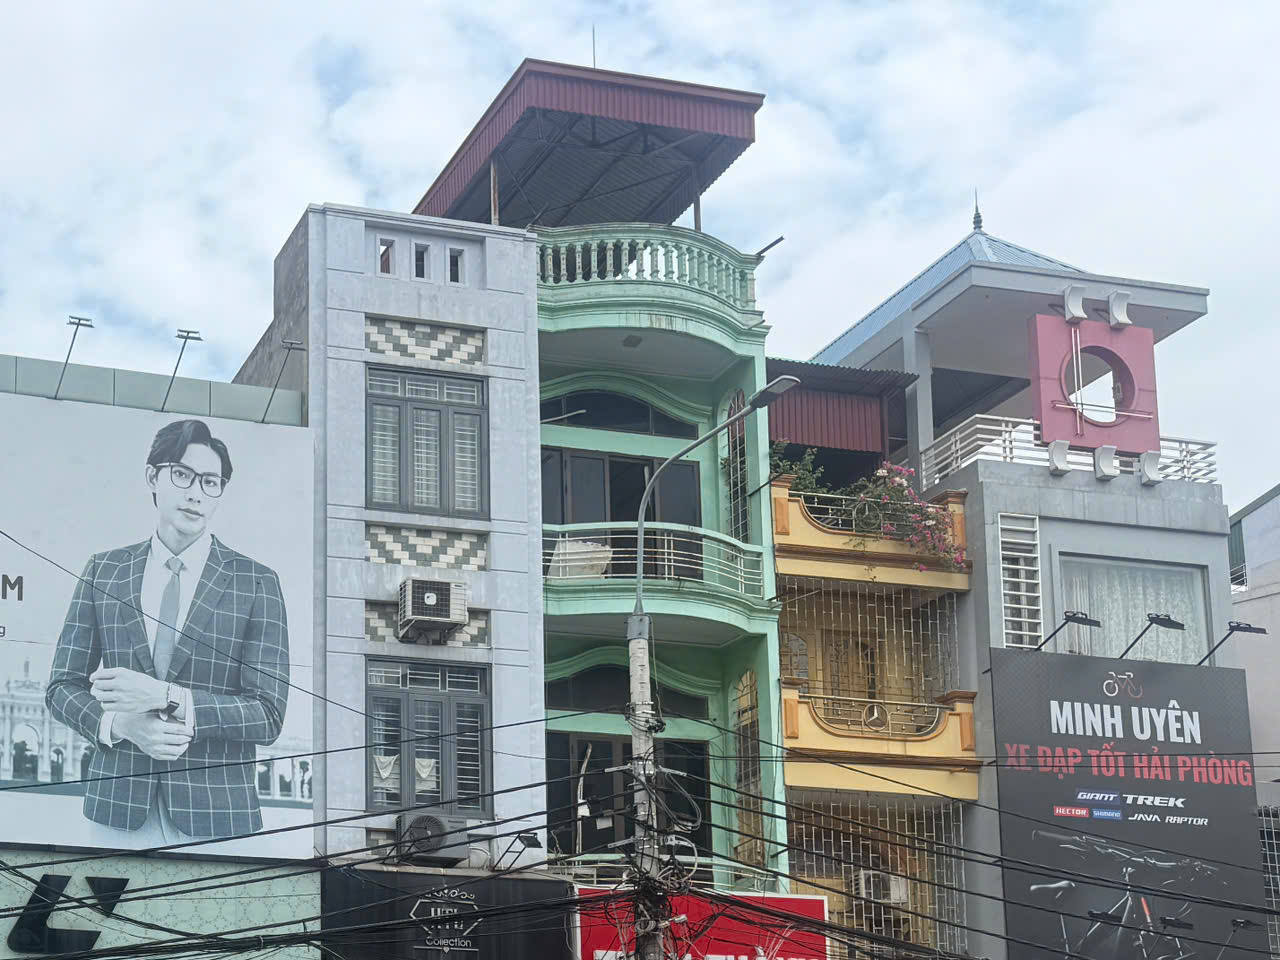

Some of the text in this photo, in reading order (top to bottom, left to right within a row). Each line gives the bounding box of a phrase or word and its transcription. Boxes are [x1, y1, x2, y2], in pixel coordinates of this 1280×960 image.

[1050, 699, 1202, 744] MINH UYÊN
[1005, 741, 1253, 786] XE ĐẠP TỐT HẢI PHÒNG
[1077, 791, 1187, 808] GIANT TREK
[1128, 813, 1161, 823] JAVA
[1165, 815, 1209, 826] RAPTOR
